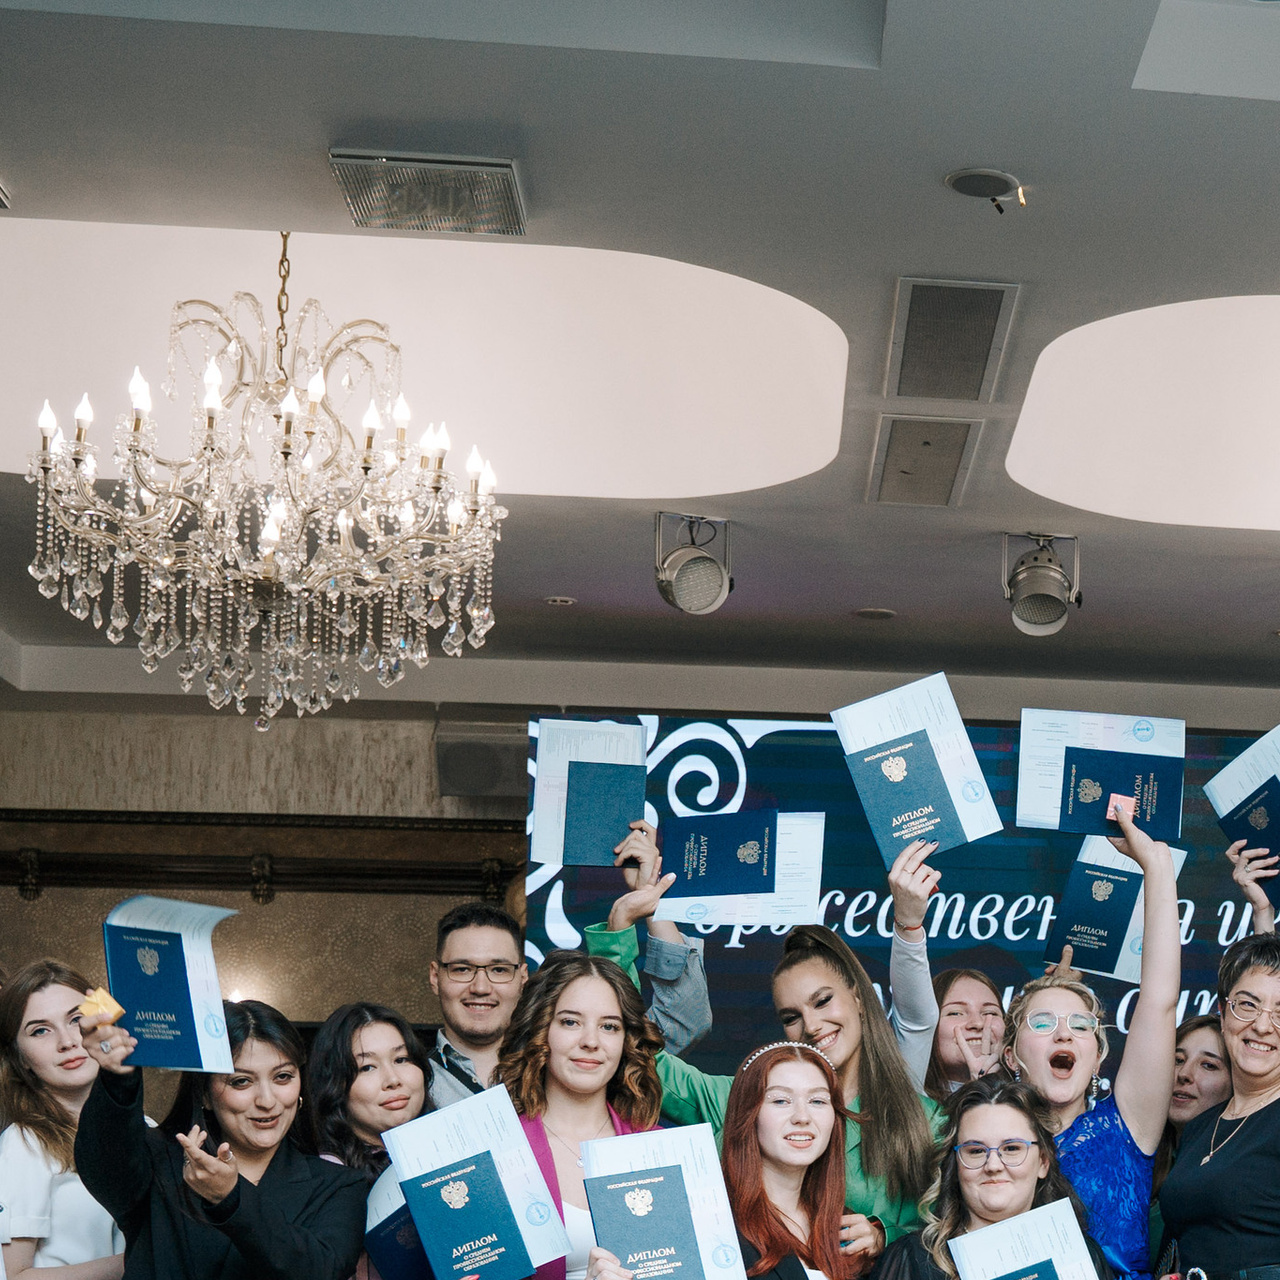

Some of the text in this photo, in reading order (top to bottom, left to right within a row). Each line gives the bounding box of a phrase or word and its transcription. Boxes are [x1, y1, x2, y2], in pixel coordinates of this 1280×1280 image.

[890, 804, 934, 826] ДИПЛОМ
[698, 834, 707, 876] ДИПЛОМ
[1070, 924, 1108, 937] ДИПЛОМ
[134, 1010, 176, 1023] ДИПЛОМ
[449, 1232, 498, 1258] ДИПЛОМ
[625, 1246, 676, 1263] ДИПЛОМ
